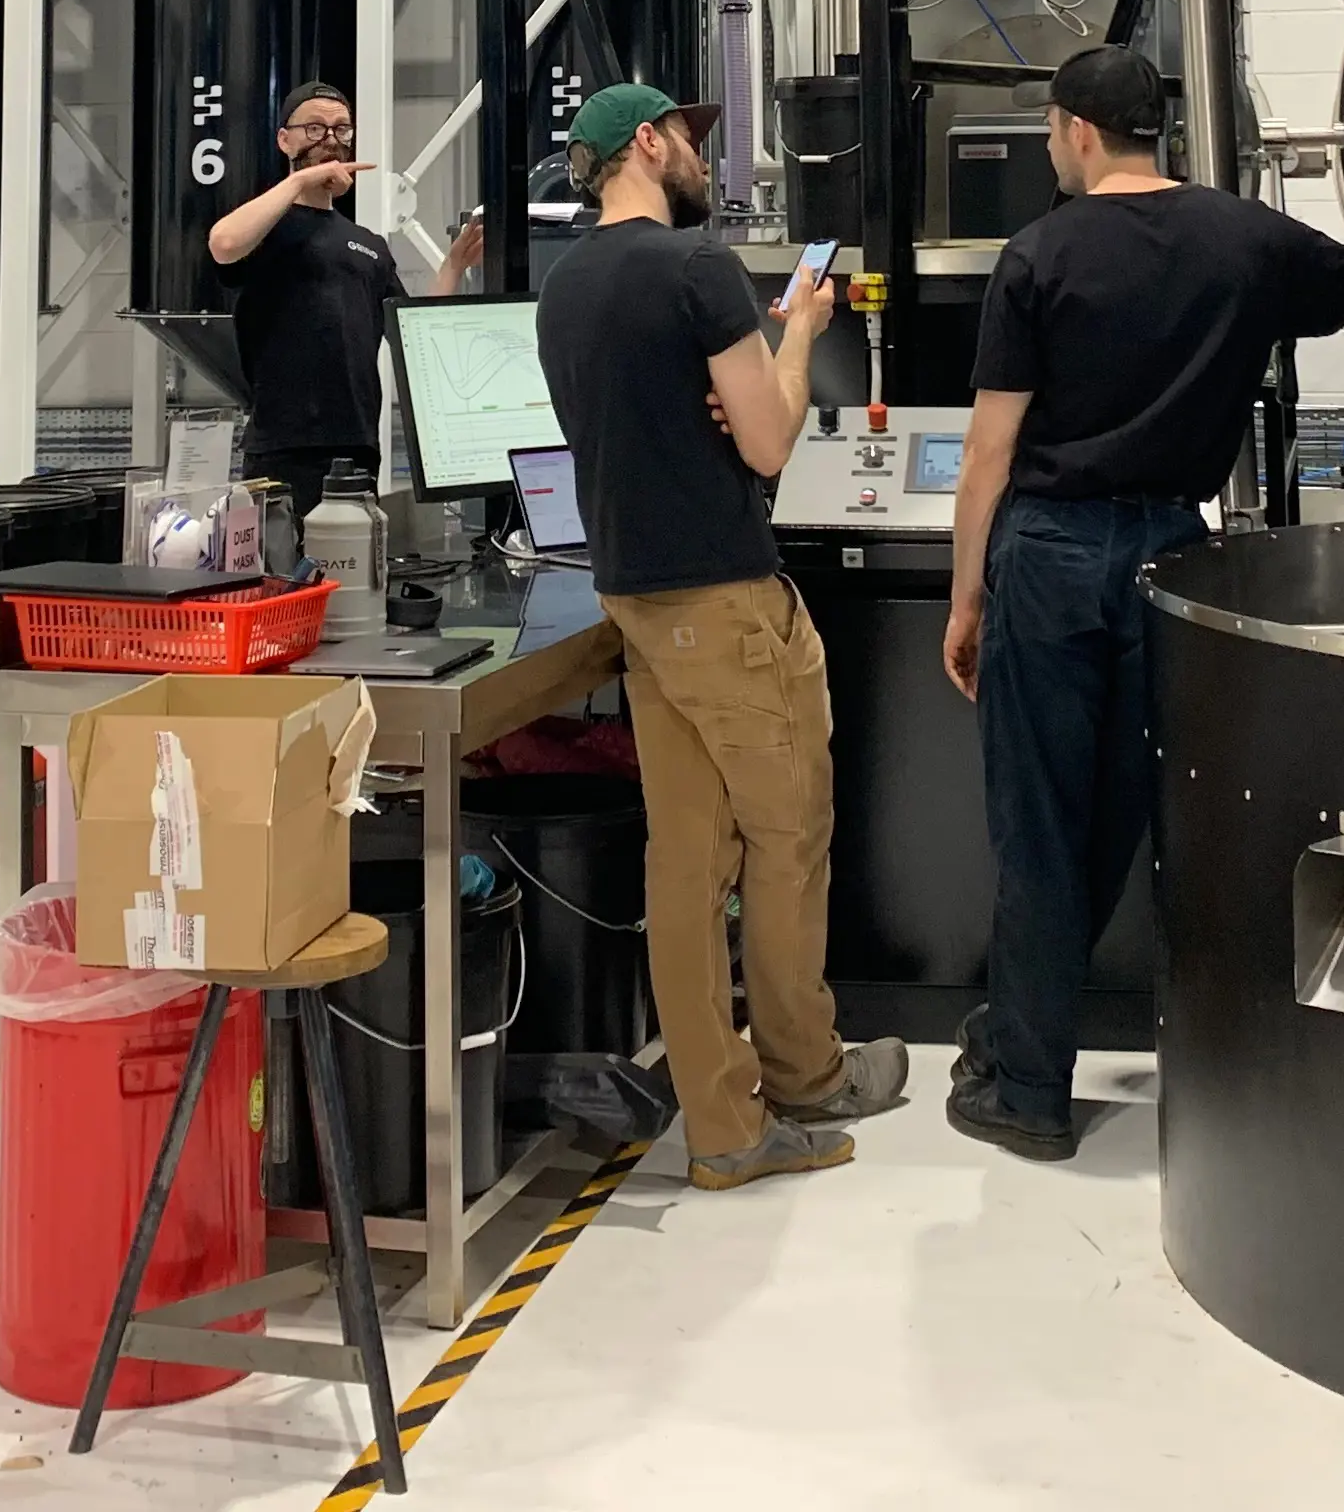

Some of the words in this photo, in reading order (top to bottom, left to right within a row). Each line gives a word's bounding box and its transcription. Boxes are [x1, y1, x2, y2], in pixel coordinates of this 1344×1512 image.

[191, 138, 225, 185] 6
[234, 526, 256, 546] DUST
[232, 552, 256, 573] MASK
